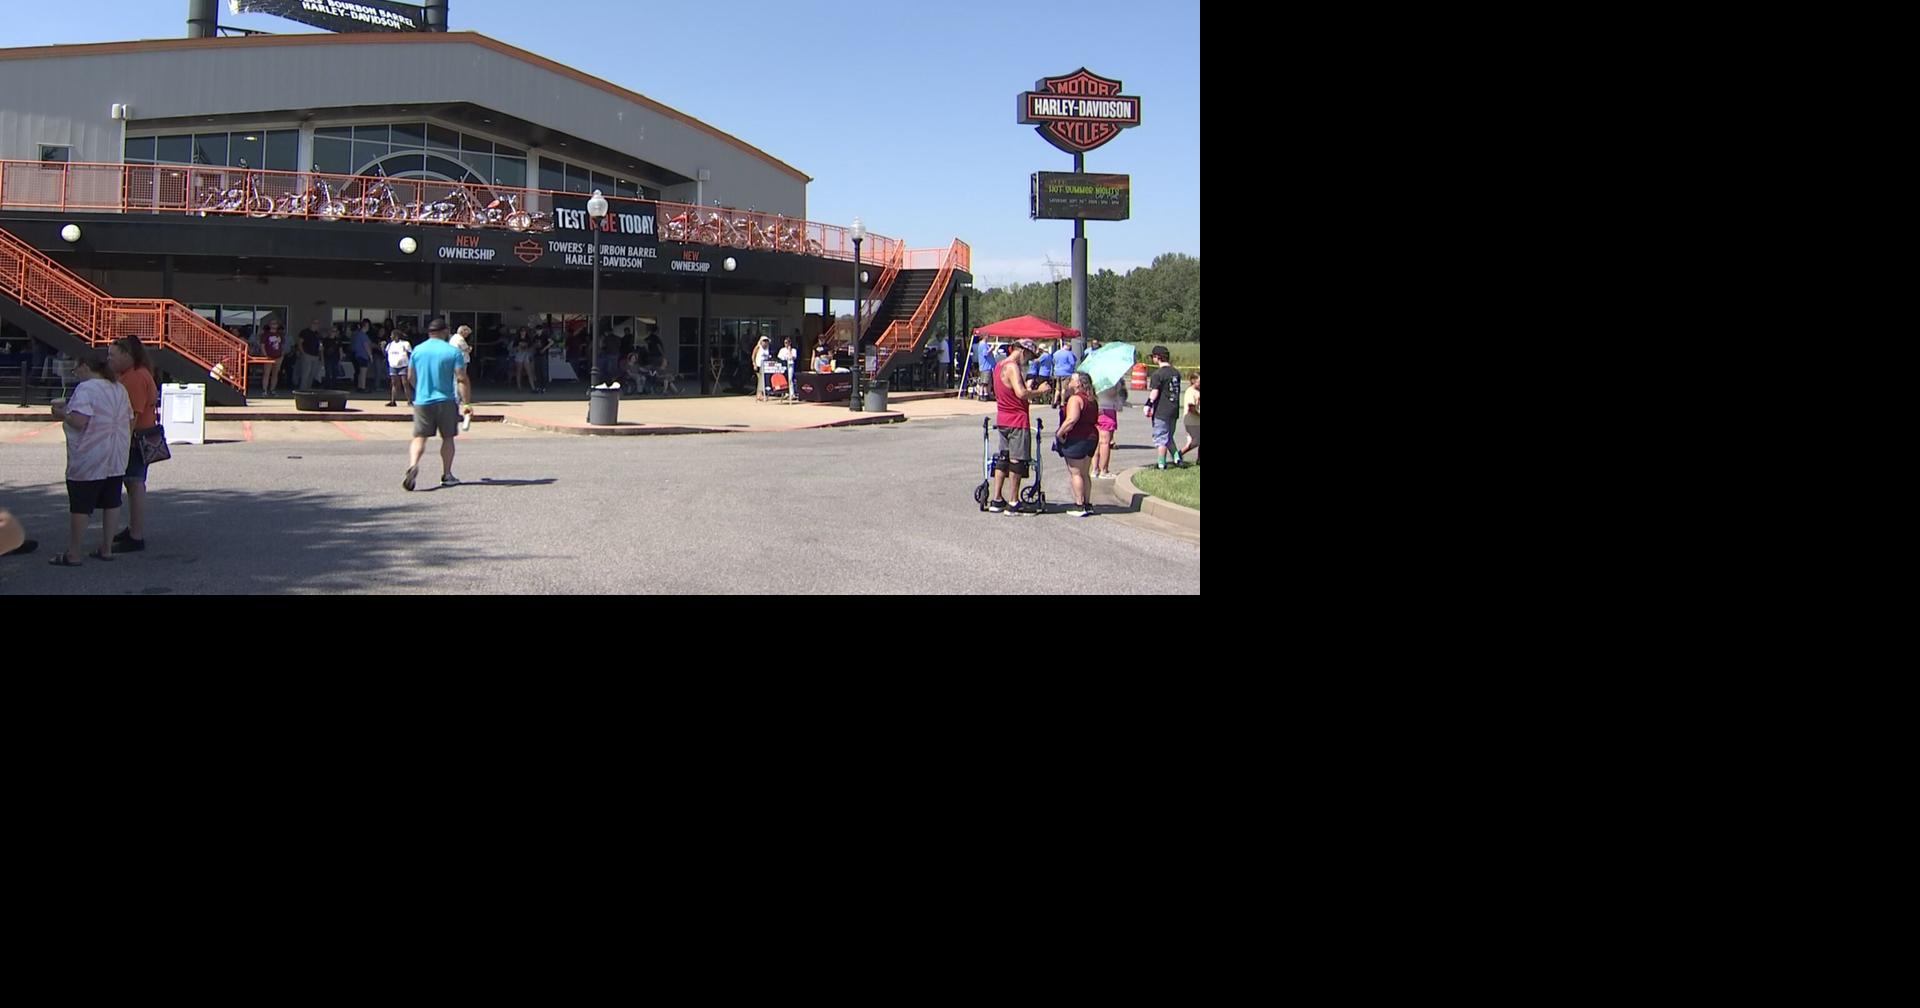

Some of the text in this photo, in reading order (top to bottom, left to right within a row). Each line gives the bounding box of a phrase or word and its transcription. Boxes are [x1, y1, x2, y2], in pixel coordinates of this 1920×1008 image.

[302, 1, 401, 30] HARLEY-DAVIDSON
[327, 0, 416, 29] BOURBON BARREL
[1057, 76, 1109, 96] MOTOR
[1034, 98, 1131, 118] HARLEY-DAVIDSON
[1057, 121, 1109, 145] CYCLES
[556, 208, 655, 235] TEST RDE TODAY
[456, 235, 480, 247] NEW
[548, 241, 586, 254] TOWERS'
[627, 246, 657, 258] BARREL
[438, 246, 496, 260] OWNERSHIP
[565, 253, 643, 269] HARLE-DAVIDSON
[683, 250, 700, 261] NEW
[670, 260, 711, 273] OWNERSHIP
